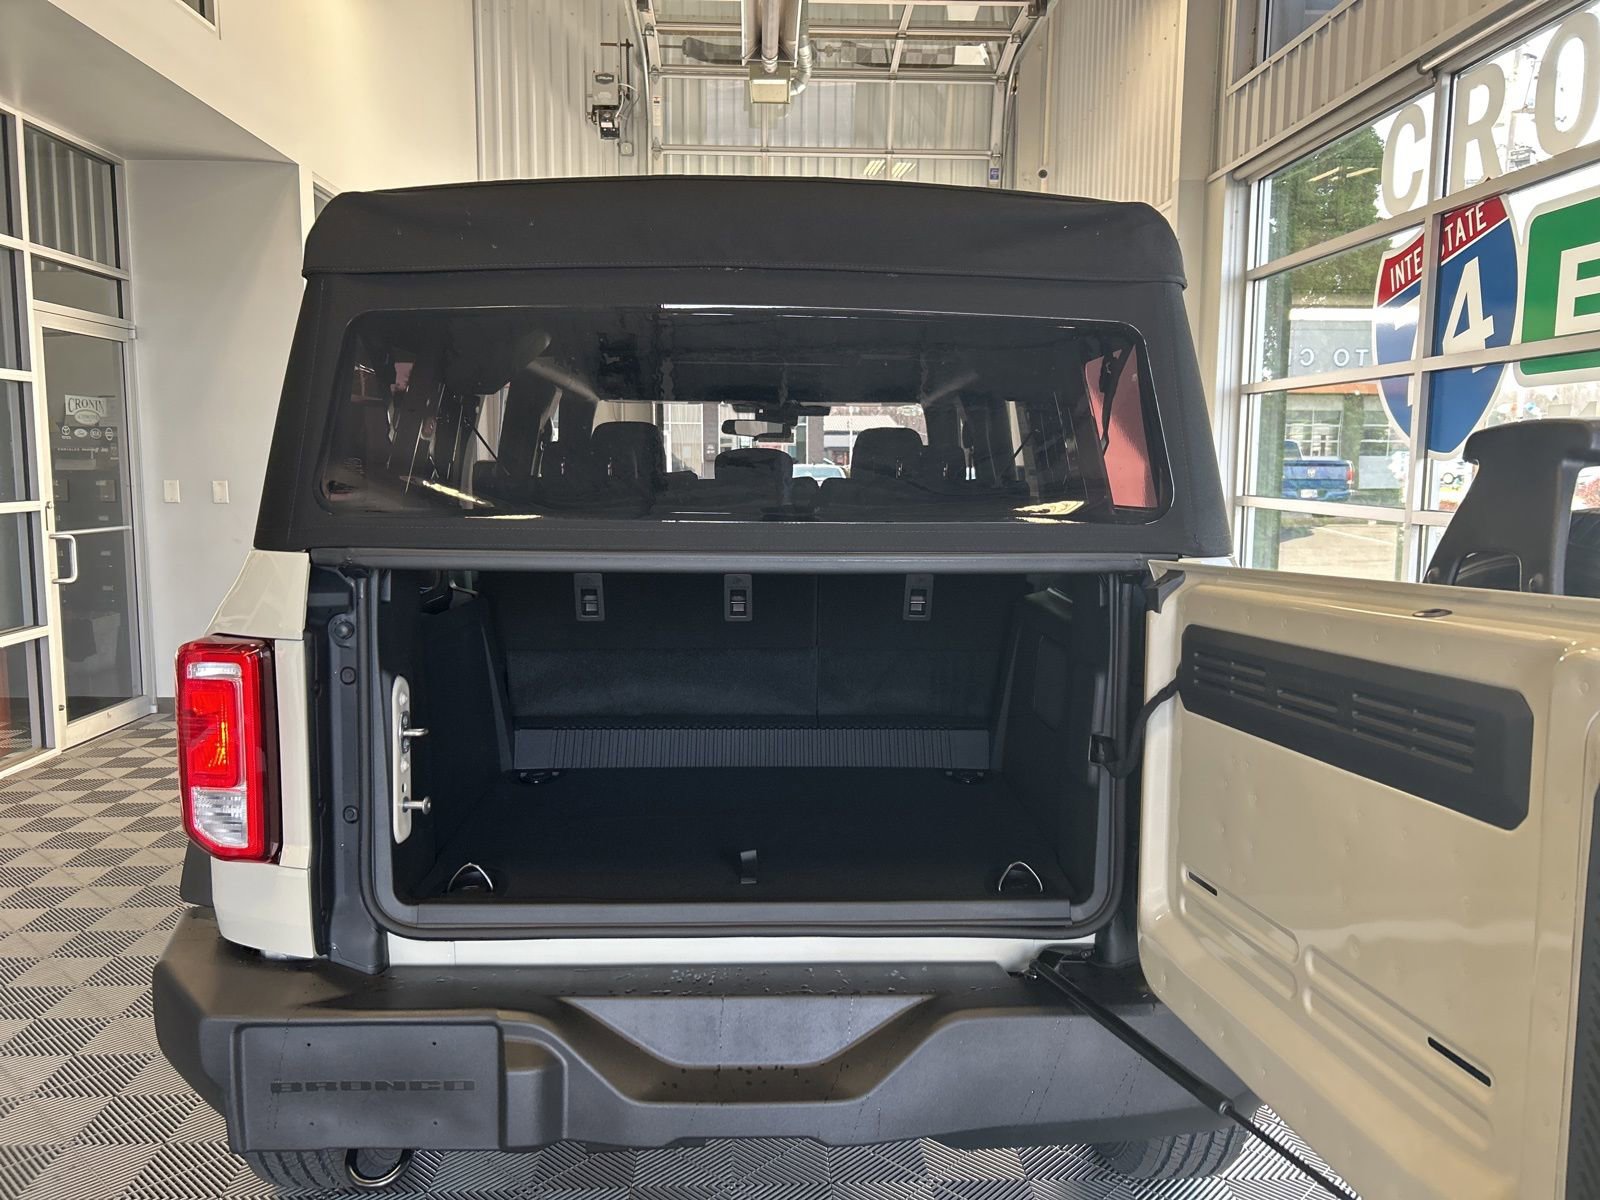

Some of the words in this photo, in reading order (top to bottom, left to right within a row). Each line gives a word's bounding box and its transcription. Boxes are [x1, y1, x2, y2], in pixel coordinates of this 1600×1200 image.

[1390, 202, 1487, 292] INTETATE
[68, 397, 105, 414] CRONIN
[270, 1080, 475, 1094] BRONCO
